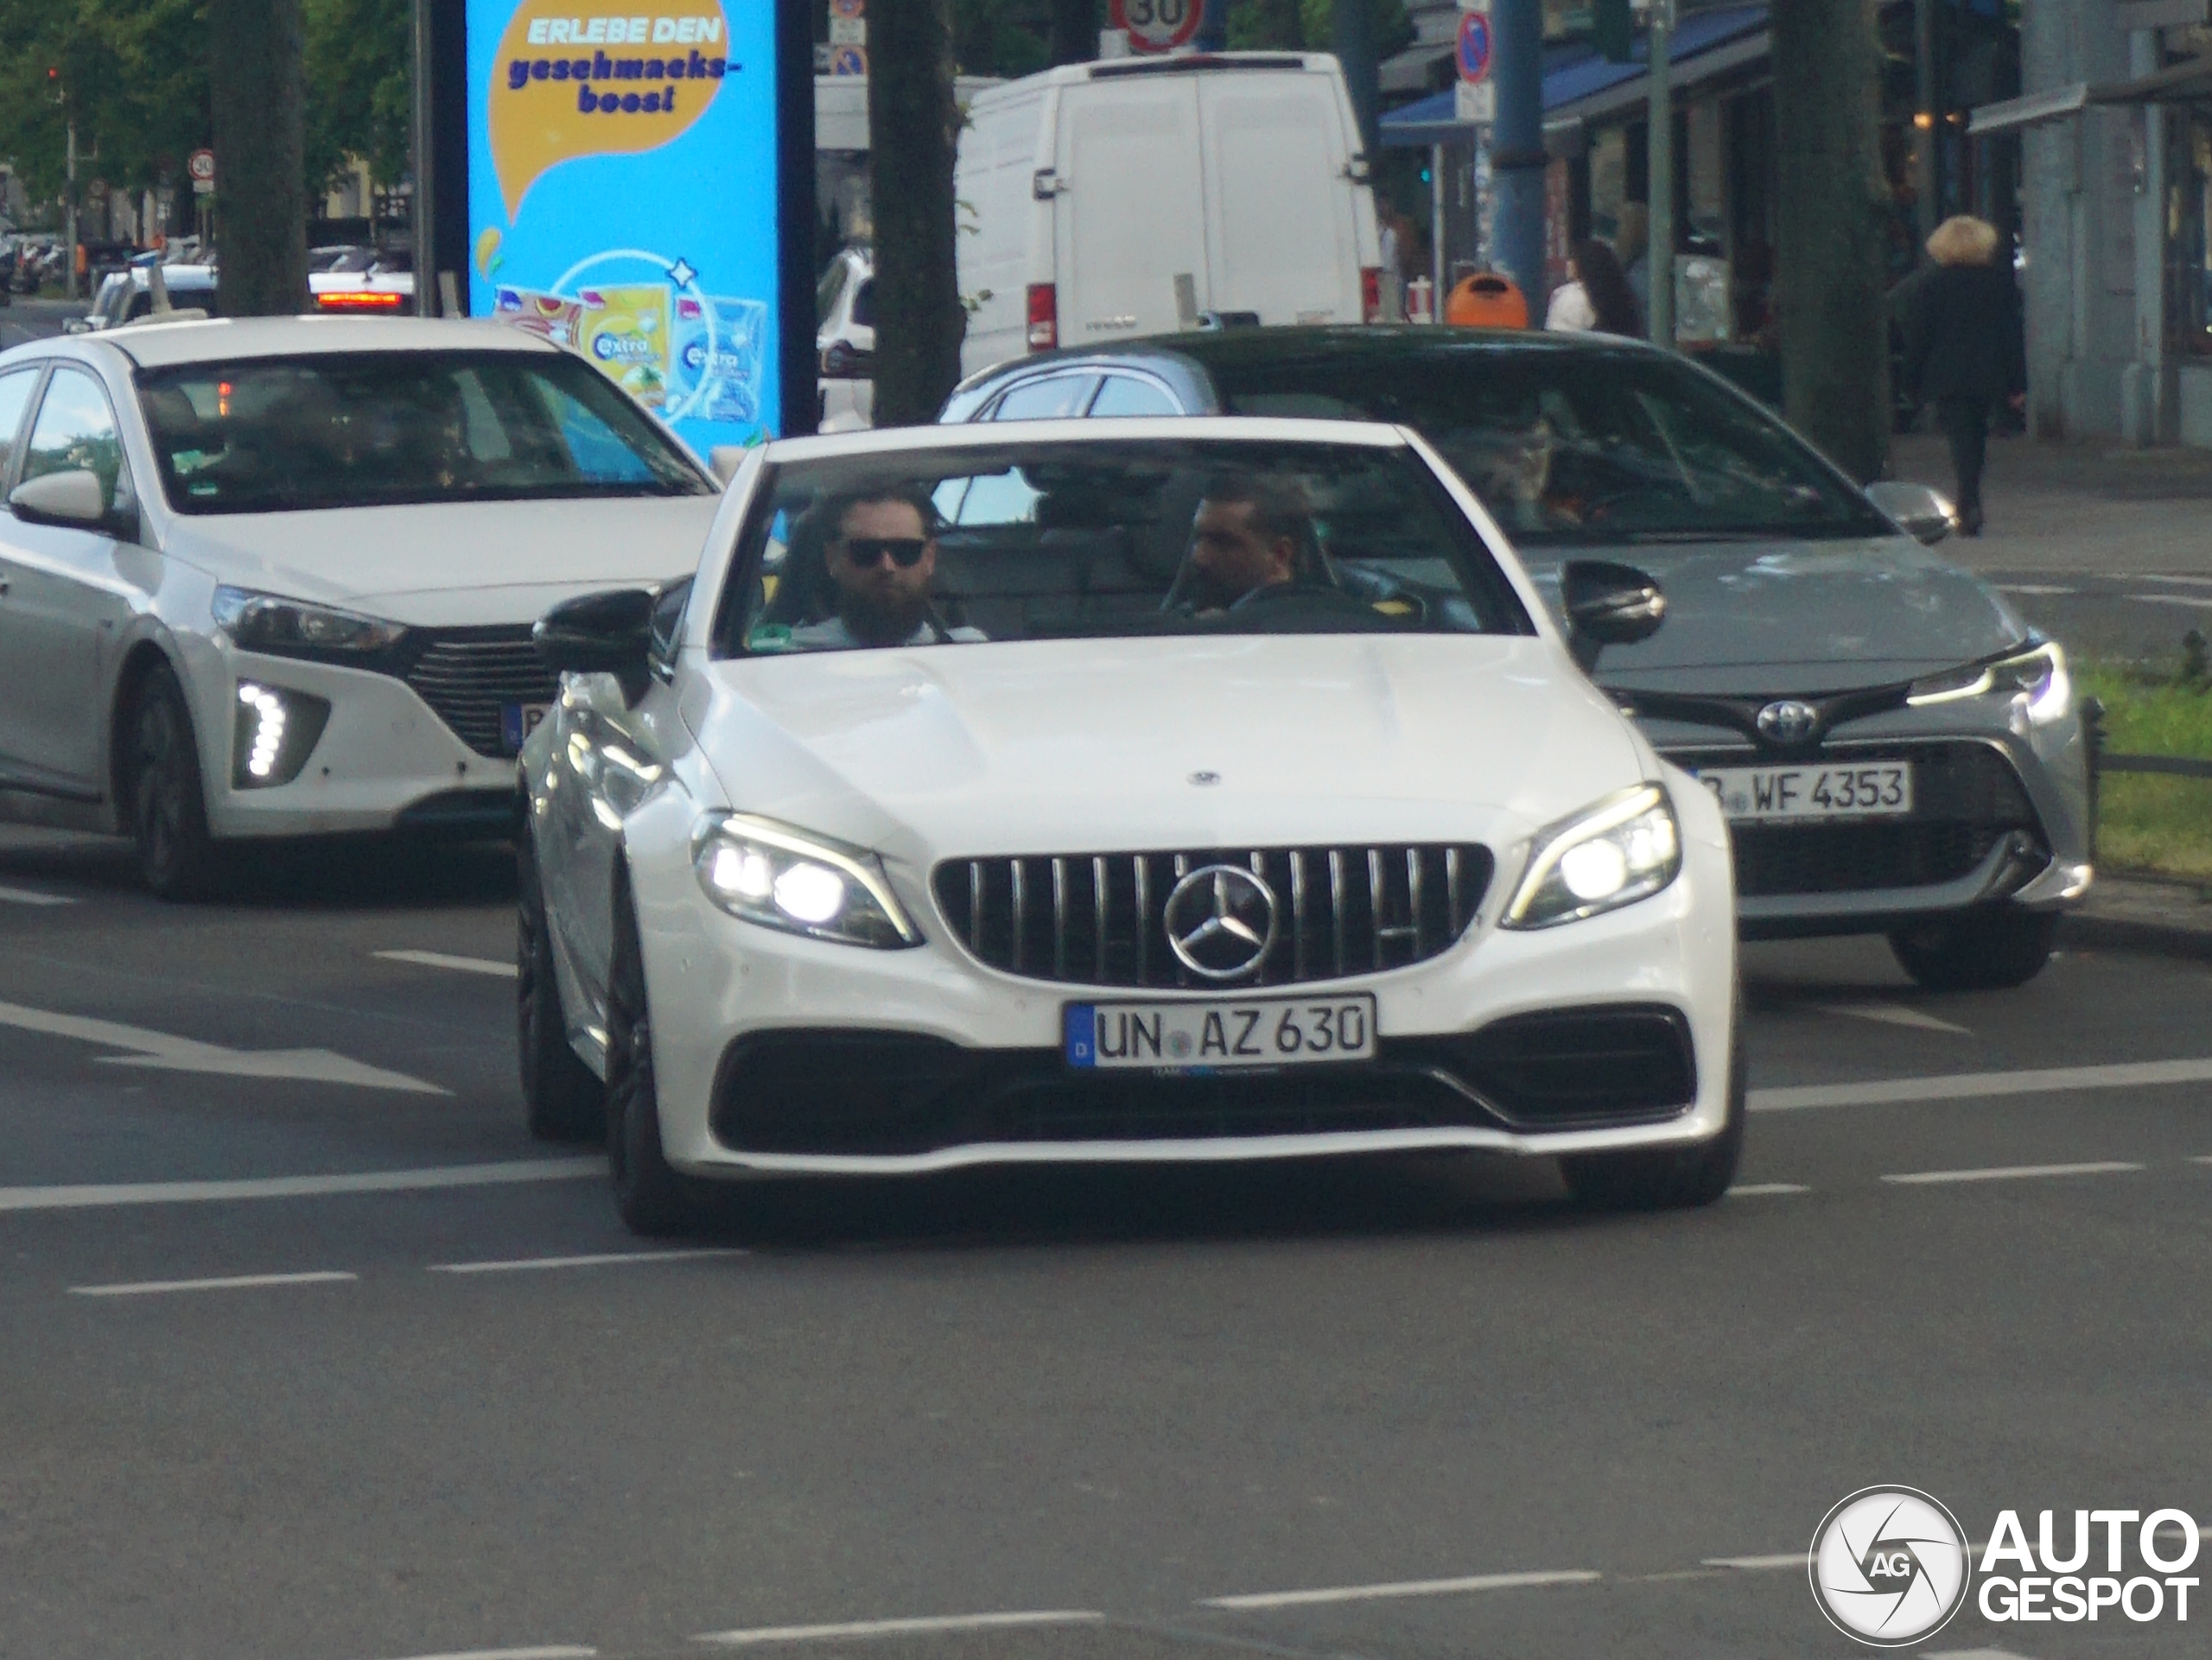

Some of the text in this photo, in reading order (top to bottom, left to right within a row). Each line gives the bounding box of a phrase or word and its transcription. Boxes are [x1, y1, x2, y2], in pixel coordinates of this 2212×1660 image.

[1128, 0, 1182, 26] 30
[527, 17, 721, 43] ERLEBE DEN
[508, 49, 742, 89] geschmacks-
[597, 336, 648, 355] extra
[1751, 772, 1802, 811] WF
[1810, 769, 1902, 808] 4353
[1096, 1005, 1363, 1058] UN AZ 630
